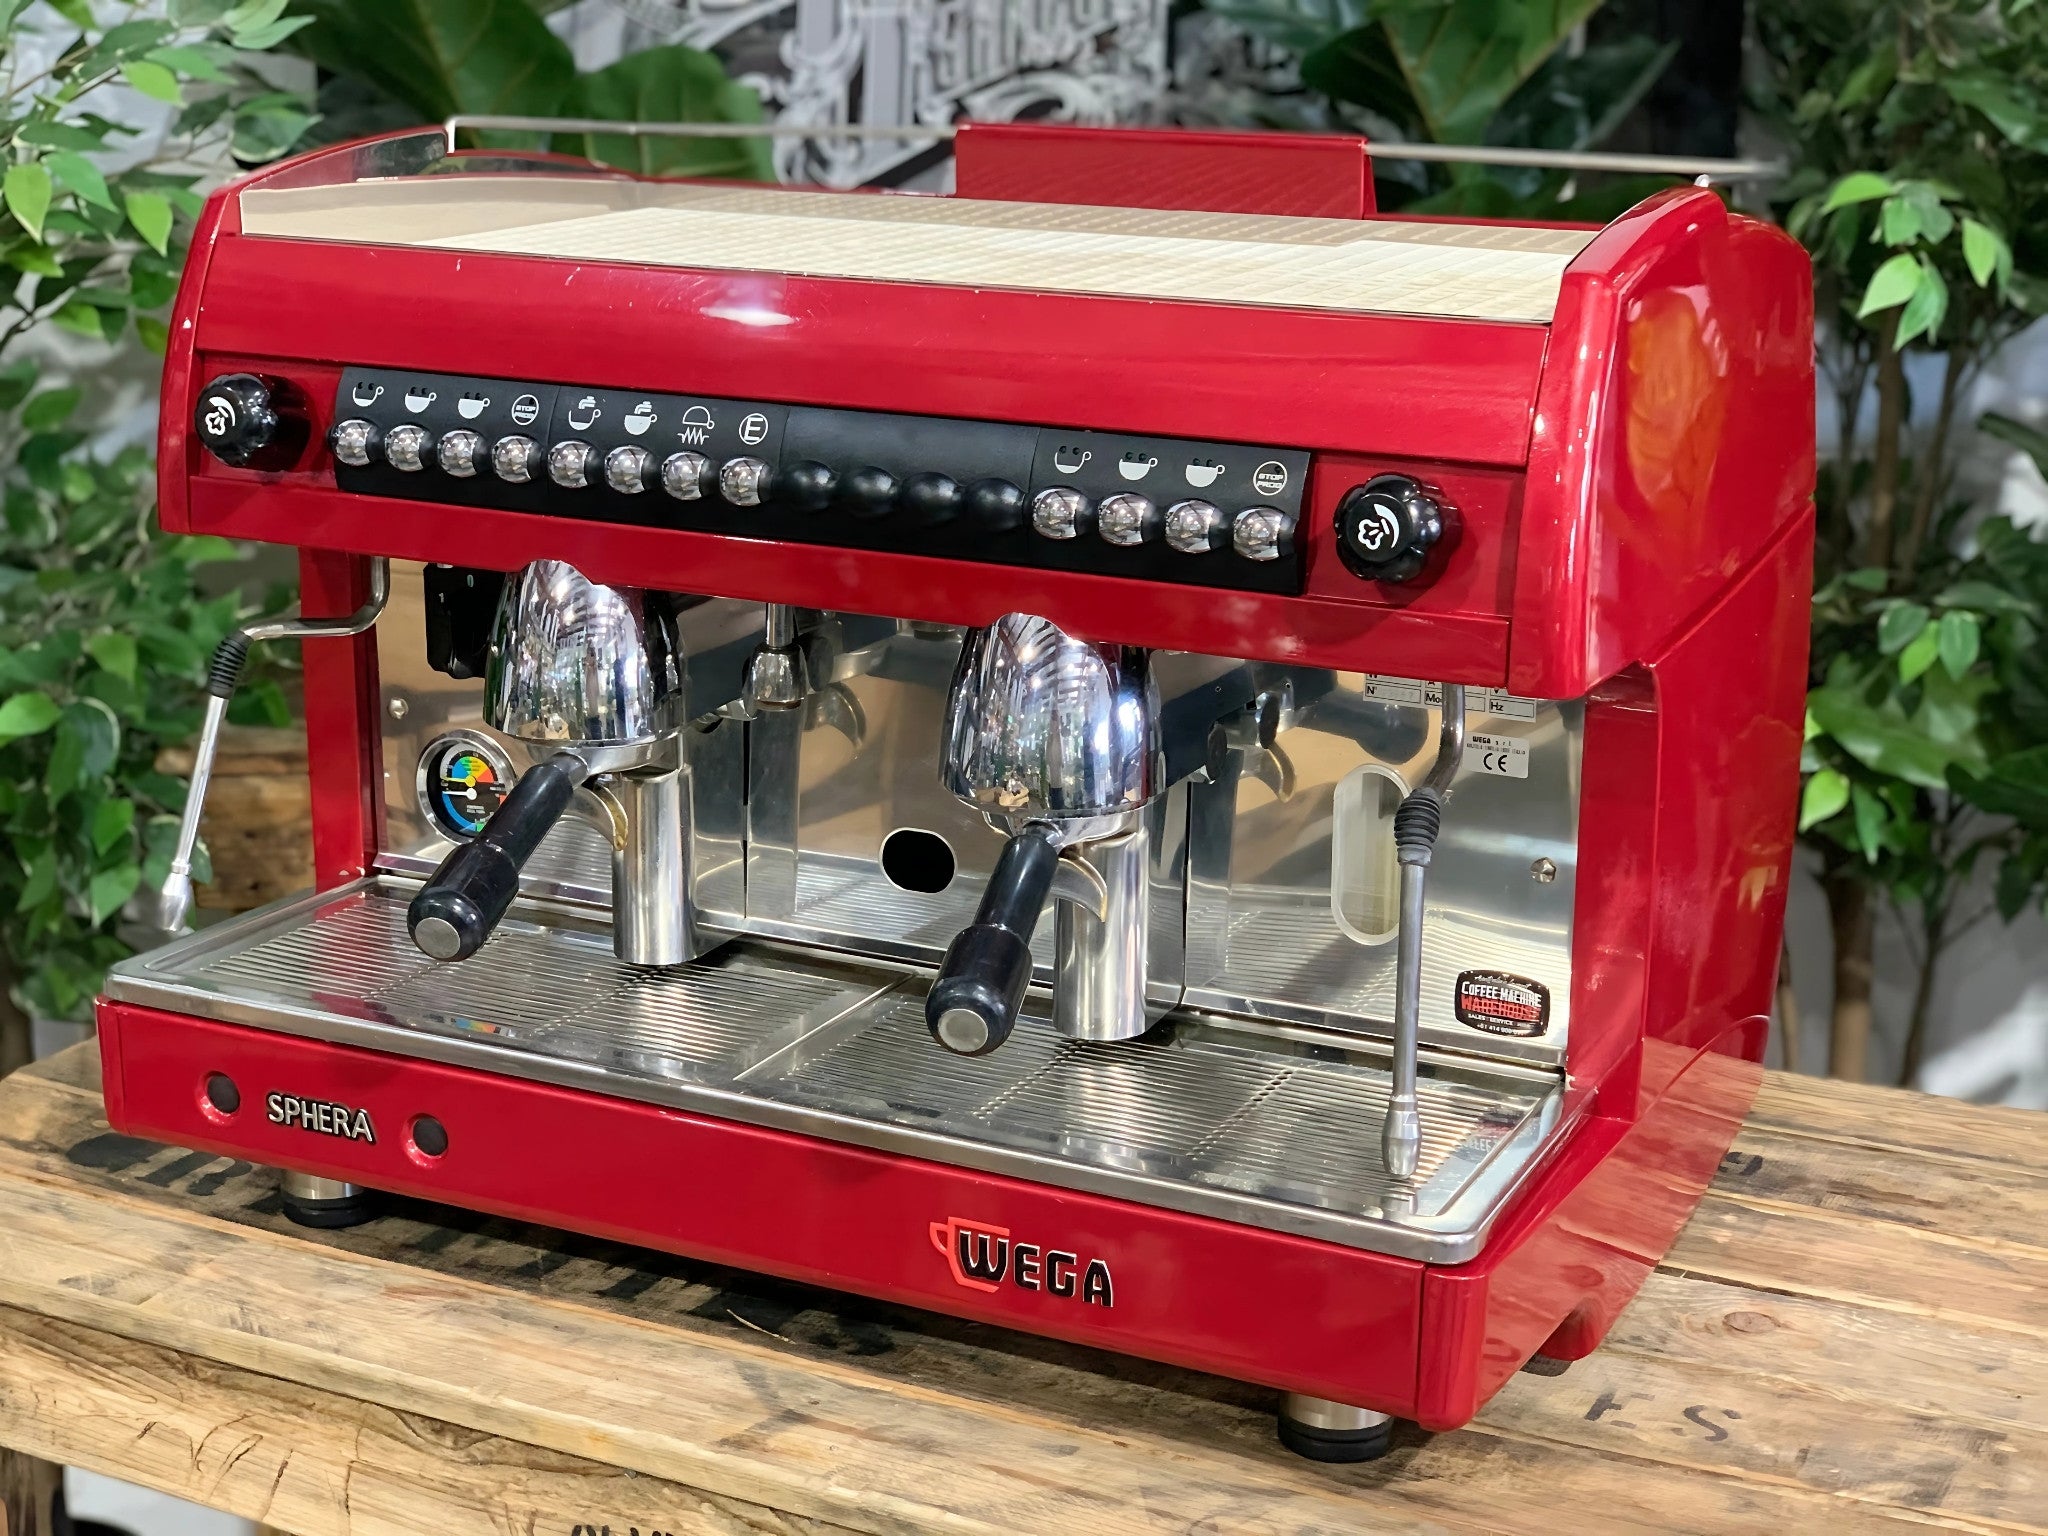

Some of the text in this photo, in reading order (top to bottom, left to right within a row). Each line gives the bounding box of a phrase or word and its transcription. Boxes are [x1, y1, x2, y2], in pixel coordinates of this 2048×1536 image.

[515, 404, 537, 412] STOP
[744, 417, 764, 440] E
[1258, 473, 1284, 481] STOP
[1490, 702, 1504, 711] Hz
[1472, 735, 1491, 744] WEGA
[1483, 752, 1508, 773] CE
[1461, 982, 1498, 999] COFFEE
[1468, 1013, 1486, 1021] SALES
[267, 1093, 374, 1143] SPHERA
[959, 1229, 1114, 1308] WEGA
